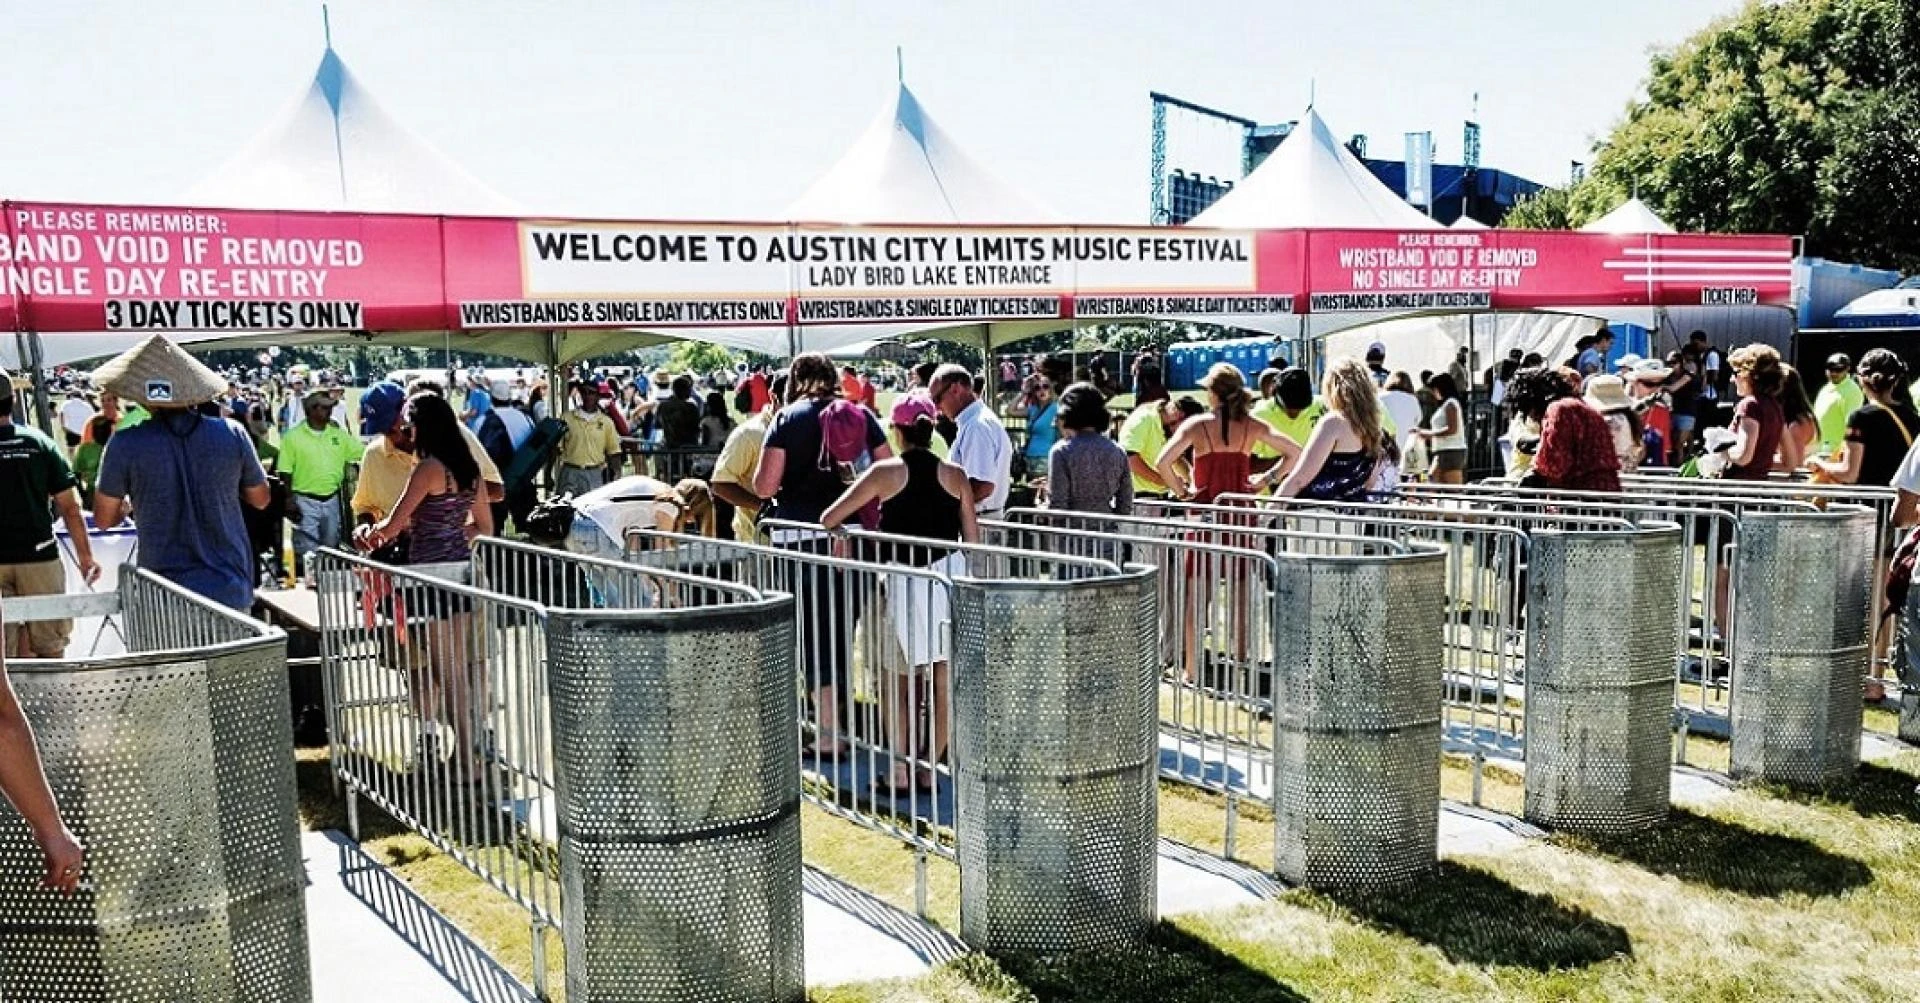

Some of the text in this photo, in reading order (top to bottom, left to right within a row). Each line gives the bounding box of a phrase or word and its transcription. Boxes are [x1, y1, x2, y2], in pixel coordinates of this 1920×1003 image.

[17, 211, 228, 233] PLEASE REMEMBER:
[98, 235, 170, 264] VOID
[182, 237, 208, 264] IF
[222, 238, 363, 266] REMOVED
[532, 232, 1249, 263] WELCOME TO AUSTIN CITY LIMITS MUSIC FESTIVAL
[1340, 249, 1537, 267] WRISTBAND VOID IF REMOVED
[106, 269, 165, 296] DAY
[179, 270, 328, 297] RE-ENTRY
[809, 265, 1053, 286] LADY BIRD LAKE ENTRANCE
[1353, 269, 1521, 288] NO SINGLE DAY RE-ENTRY
[1076, 298, 1155, 315] WRISTBANDS
[1166, 298, 1205, 314] SINGLE
[1205, 297, 1226, 313] DAY
[1227, 297, 1269, 312] TICKETS
[1270, 297, 1292, 312] ONLY
[1312, 295, 1376, 309] WRISTBANDS
[1385, 295, 1417, 308] SINGLE
[1435, 294, 1470, 307] TICKETS
[1703, 287, 1757, 304] TICKET HELP
[107, 301, 360, 328] 3 DAY TICKETS ONLY
[462, 302, 786, 324] WRISTBANDS & SINGLE DAY TICKETS ONLY
[799, 299, 892, 319] WRISTBANDS
[907, 299, 953, 317] SINGLE
[954, 298, 979, 317] DAY
[981, 297, 1030, 316] TICKETS
[1032, 297, 1058, 315] ONLY
